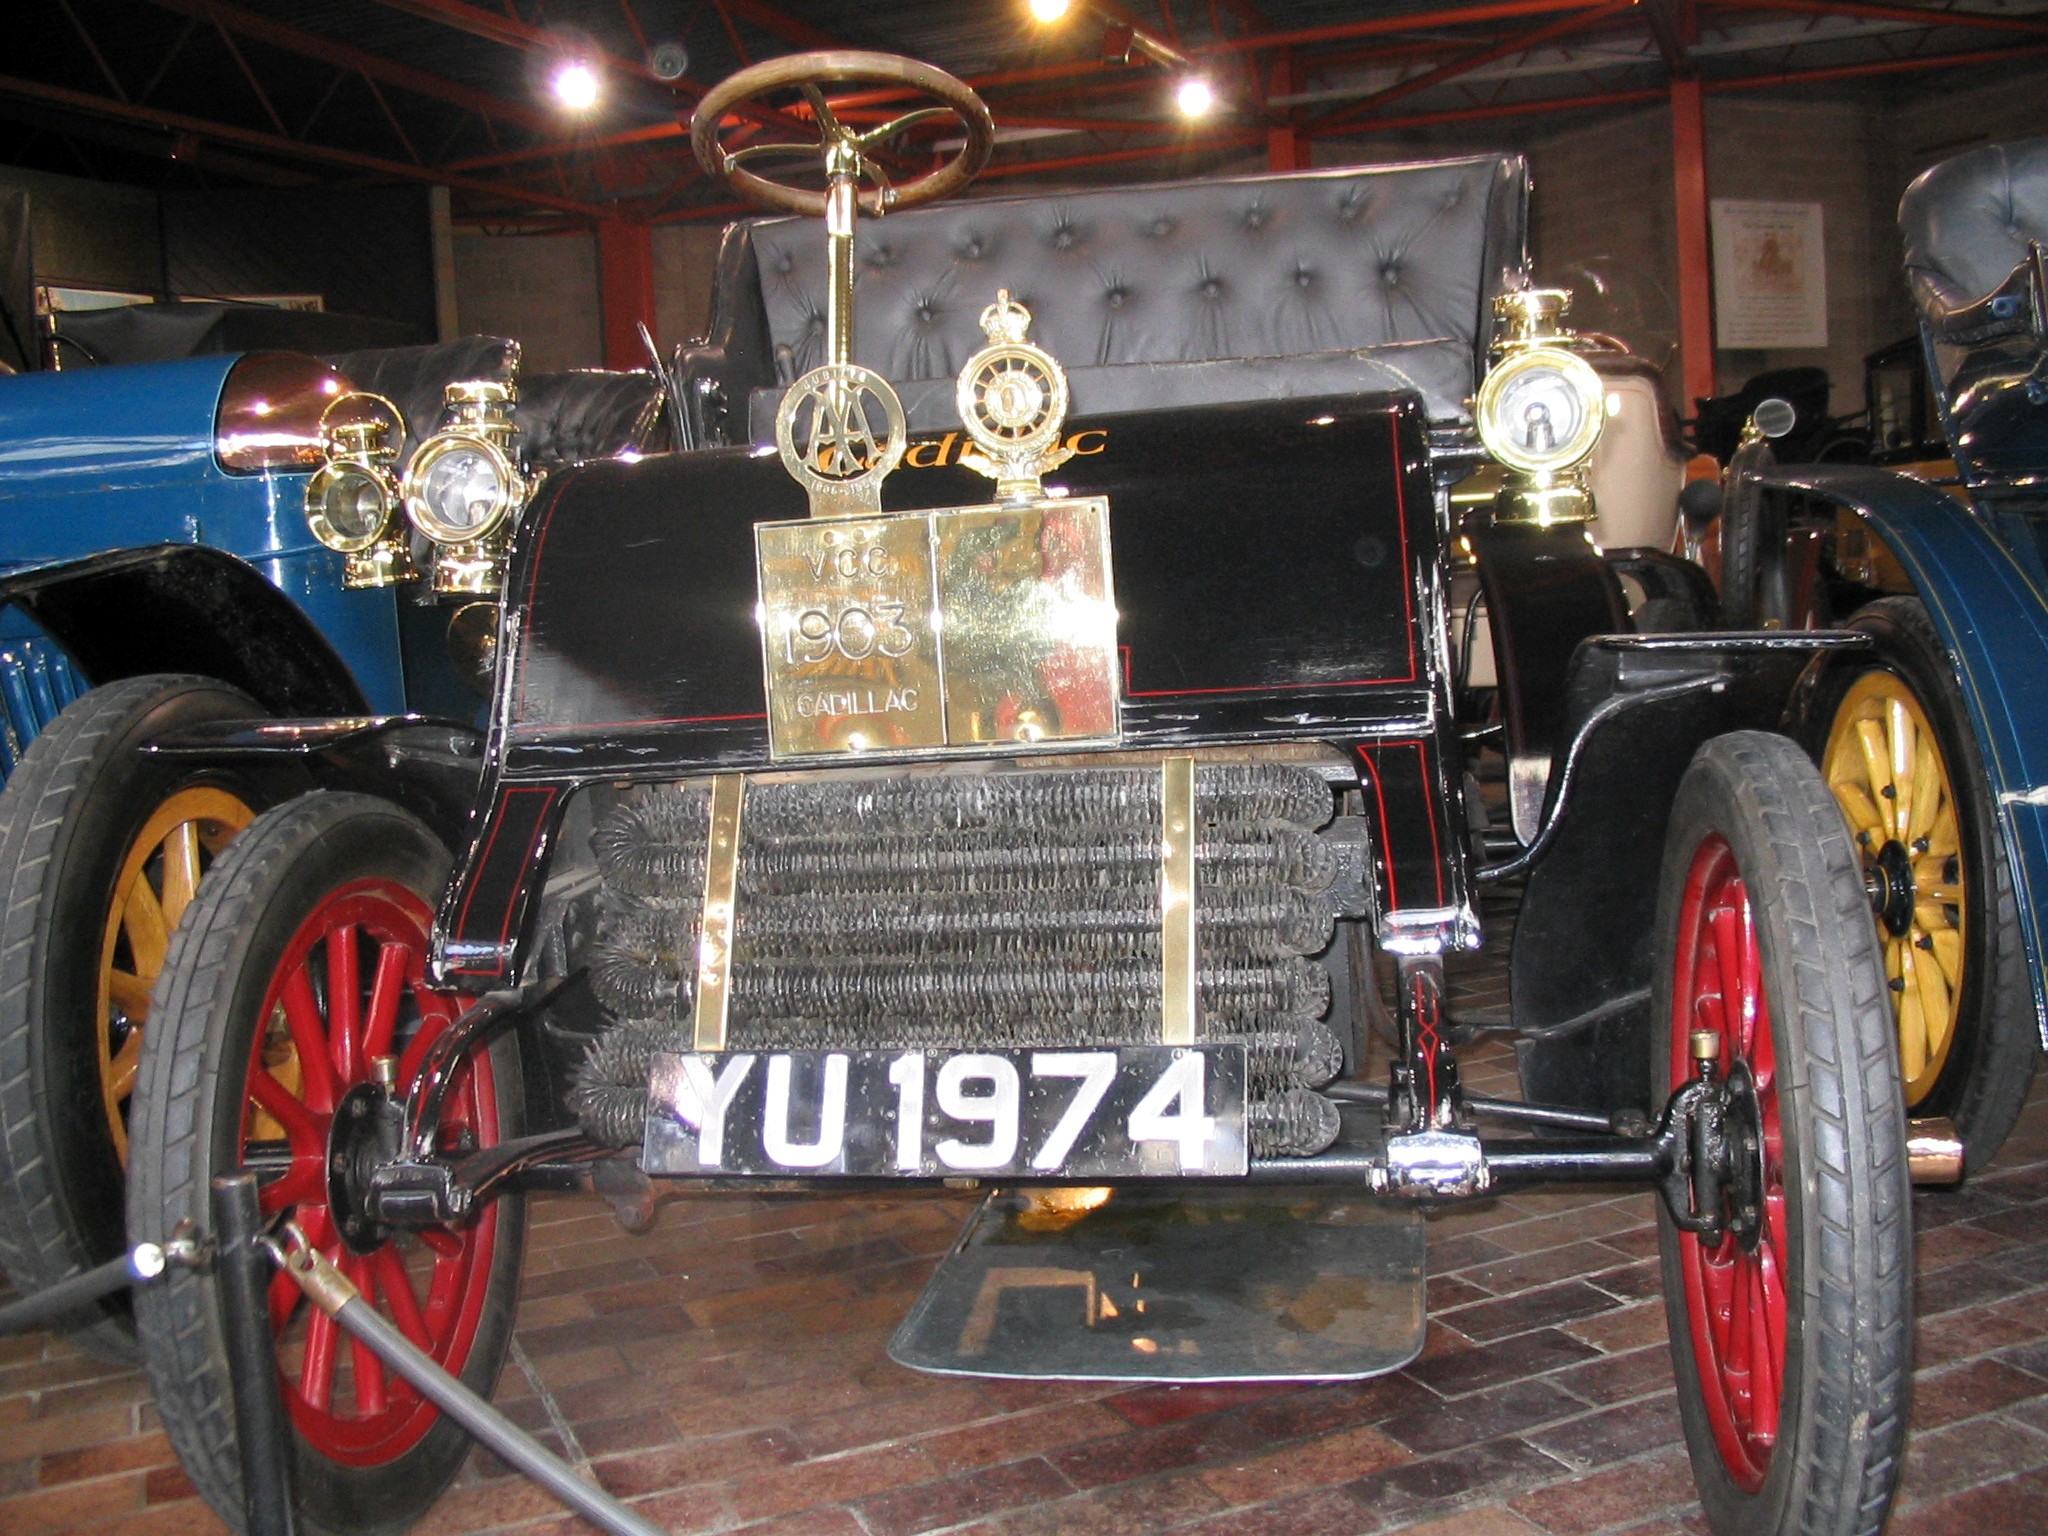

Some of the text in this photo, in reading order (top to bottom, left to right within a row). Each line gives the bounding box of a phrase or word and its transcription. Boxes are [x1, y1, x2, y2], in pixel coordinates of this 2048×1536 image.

[779, 601, 914, 665] 1903
[797, 688, 918, 718] CADILLAC
[681, 1050, 1216, 1173] YU 1974
